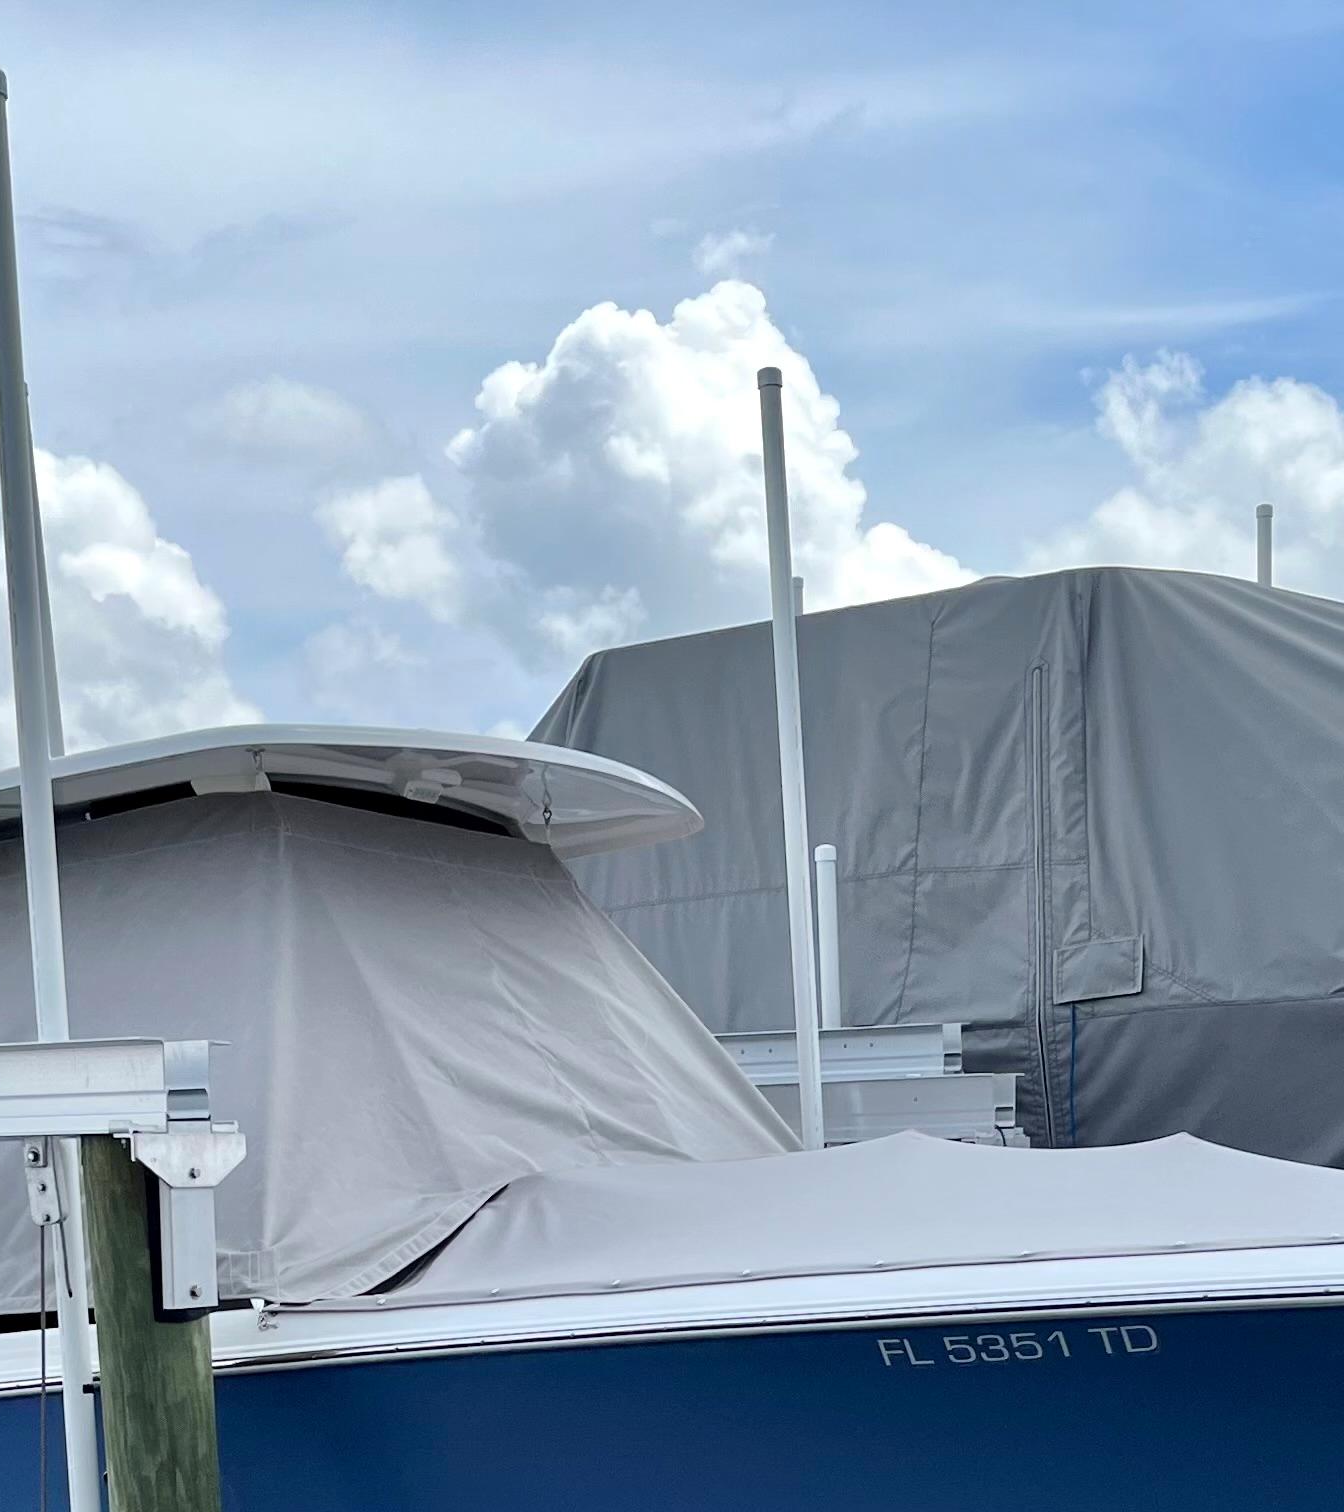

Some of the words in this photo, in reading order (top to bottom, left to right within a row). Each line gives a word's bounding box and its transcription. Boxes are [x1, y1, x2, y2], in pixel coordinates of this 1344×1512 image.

[877, 1338, 935, 1366] FL
[943, 1330, 1072, 1364] 5351
[1087, 1325, 1158, 1355] TD
